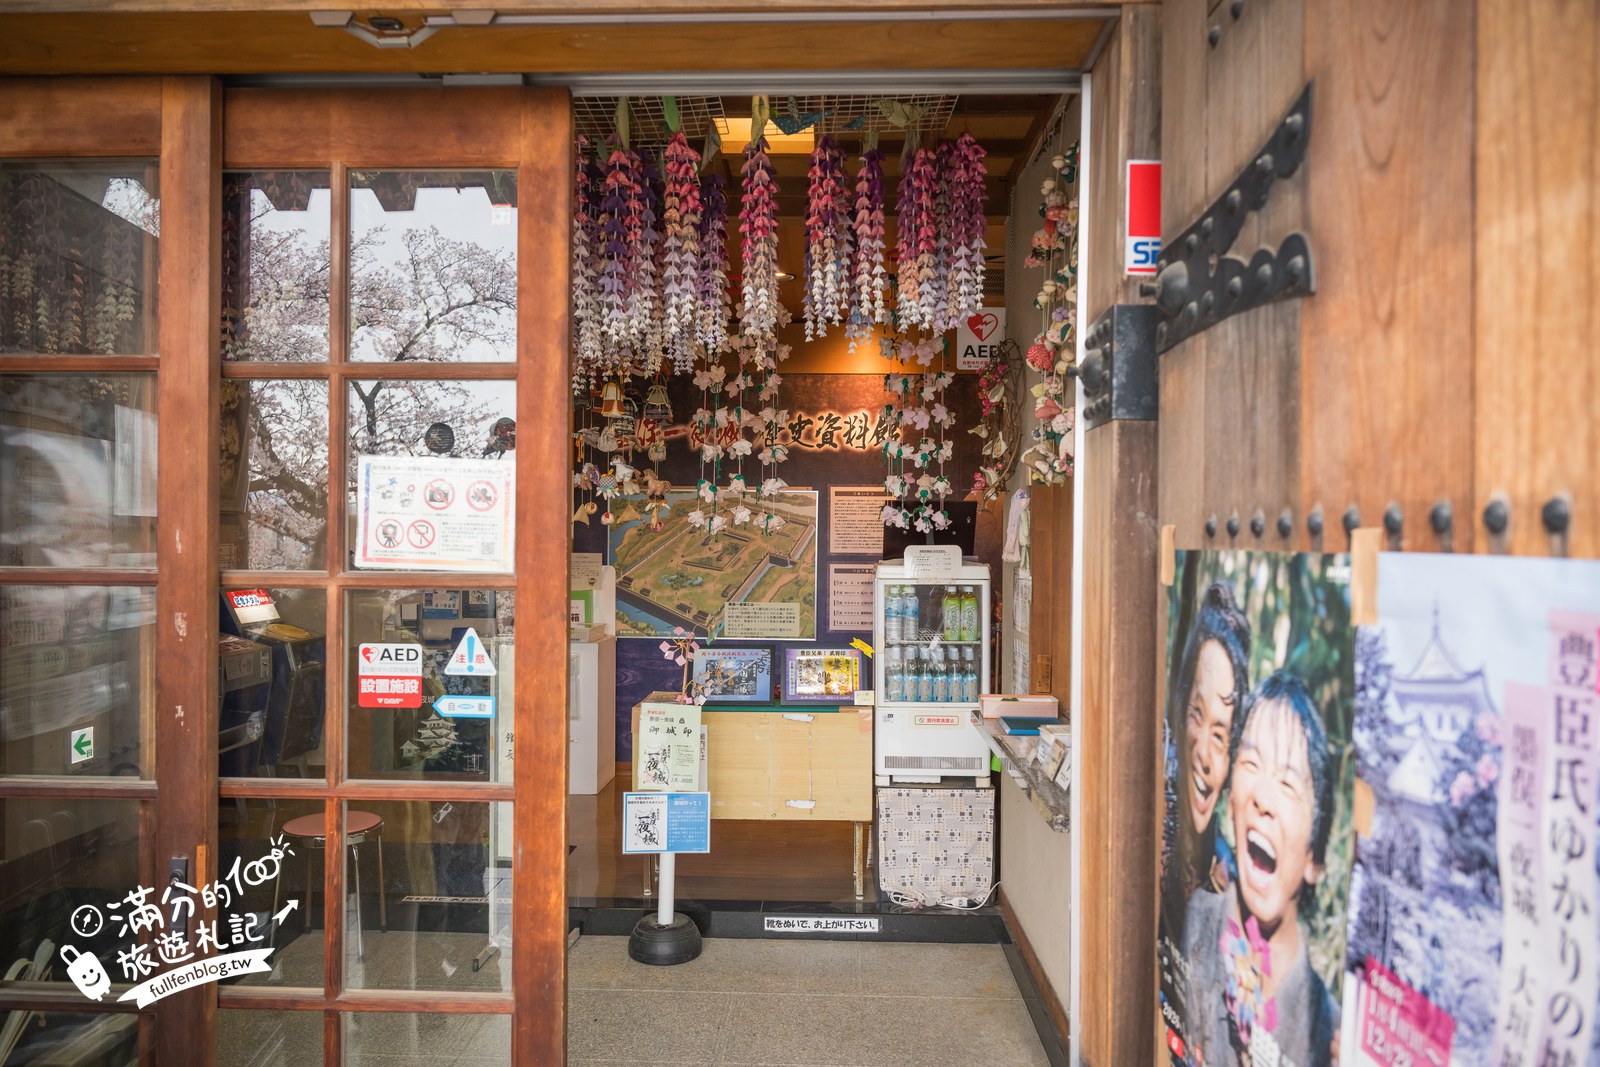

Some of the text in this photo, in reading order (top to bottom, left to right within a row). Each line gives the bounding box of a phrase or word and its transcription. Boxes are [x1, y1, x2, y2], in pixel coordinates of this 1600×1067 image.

[380, 648, 419, 661] AED
[361, 679, 419, 694] 設置施設
[766, 918, 876, 931] 靴をぬいで、お上がり下さい。
